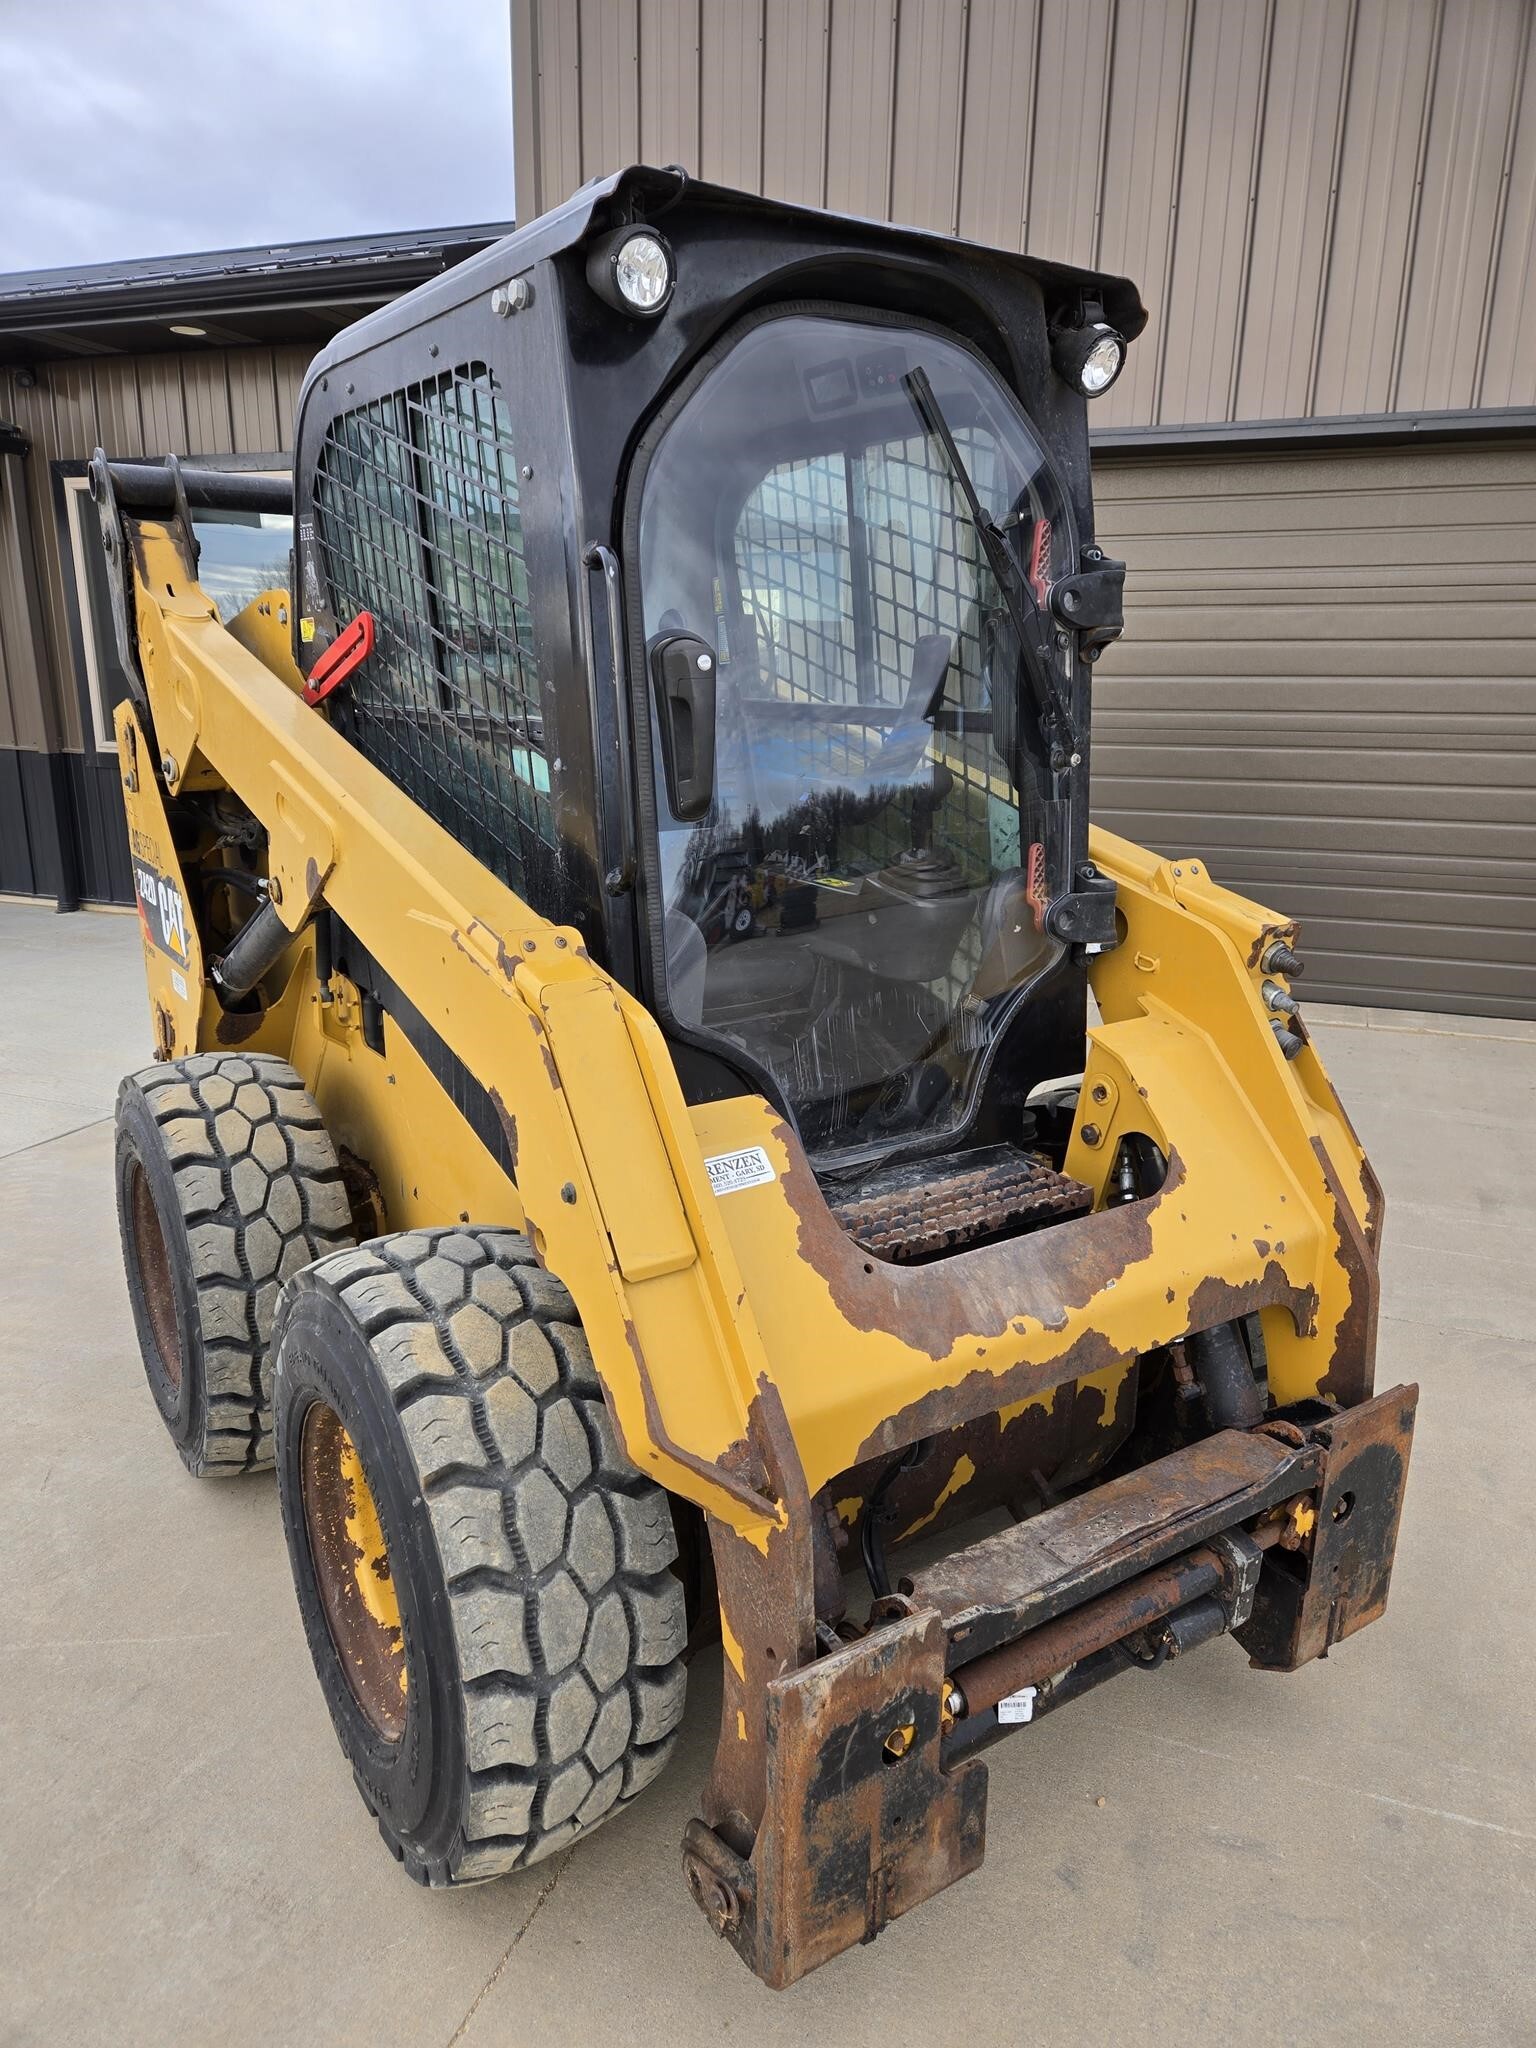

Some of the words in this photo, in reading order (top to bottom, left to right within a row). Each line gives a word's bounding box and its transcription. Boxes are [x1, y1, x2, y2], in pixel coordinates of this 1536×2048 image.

[137, 868, 157, 906] 242D
[158, 881, 187, 959] CAT
[736, 1167, 756, 1177] GARY,
[755, 1164, 765, 1172] SD
